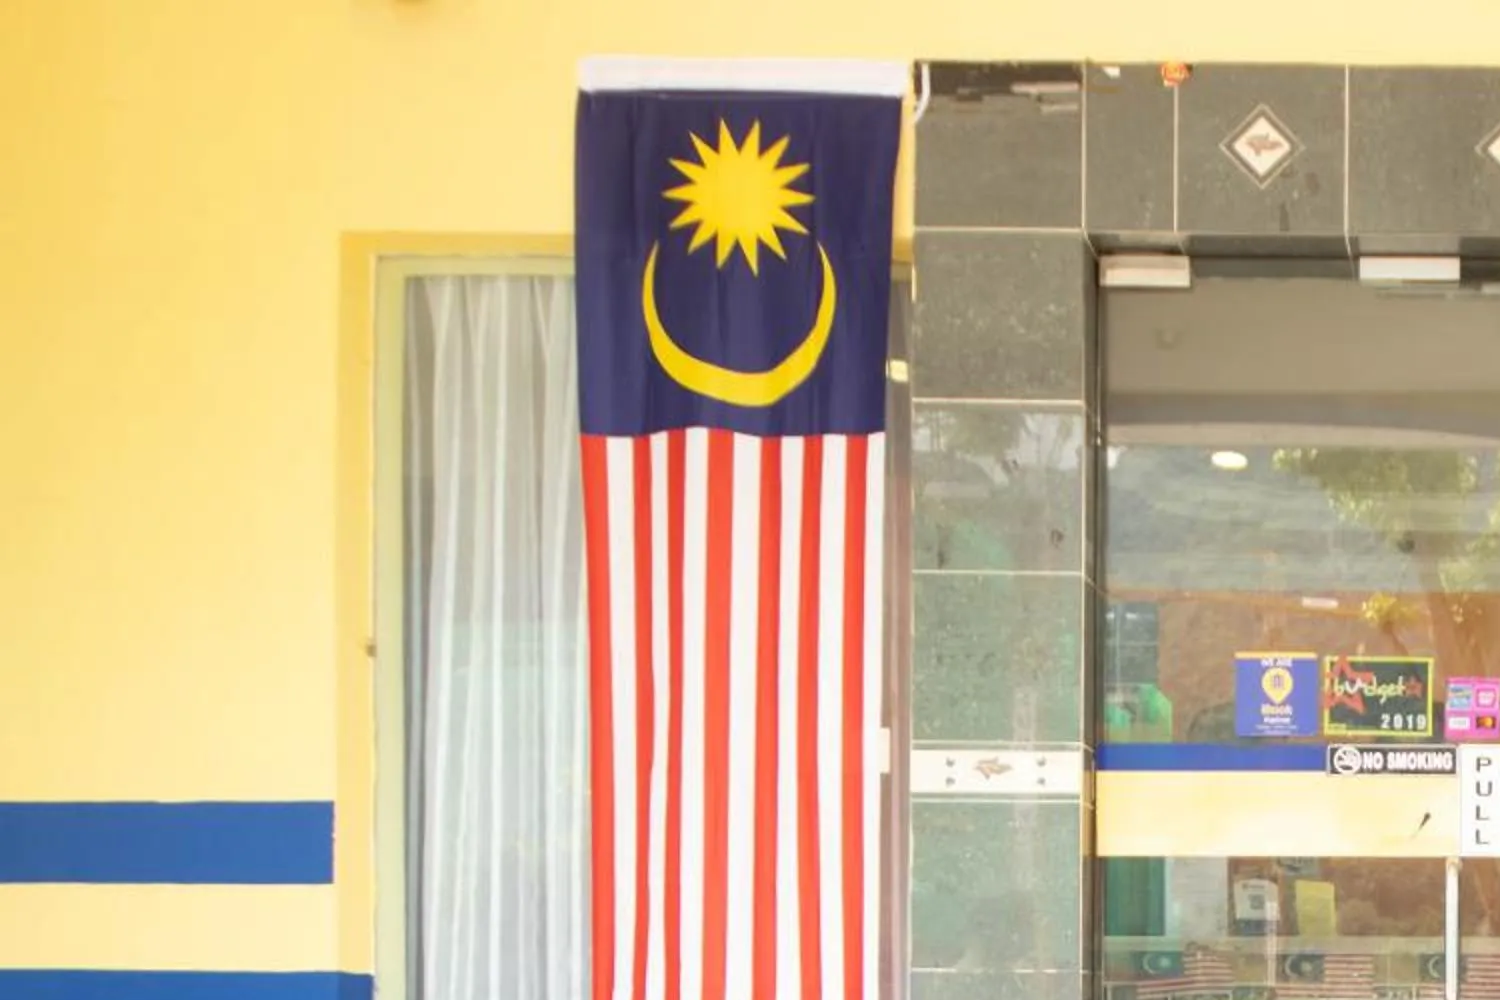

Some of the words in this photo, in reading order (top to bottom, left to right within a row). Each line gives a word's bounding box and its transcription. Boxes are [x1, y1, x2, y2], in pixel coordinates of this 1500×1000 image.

[1333, 675, 1406, 704] budget
[1380, 713, 1427, 730] 2019
[1362, 751, 1384, 770] NO
[1387, 751, 1453, 770] SMOKING
[1475, 756, 1493, 844] PULL
